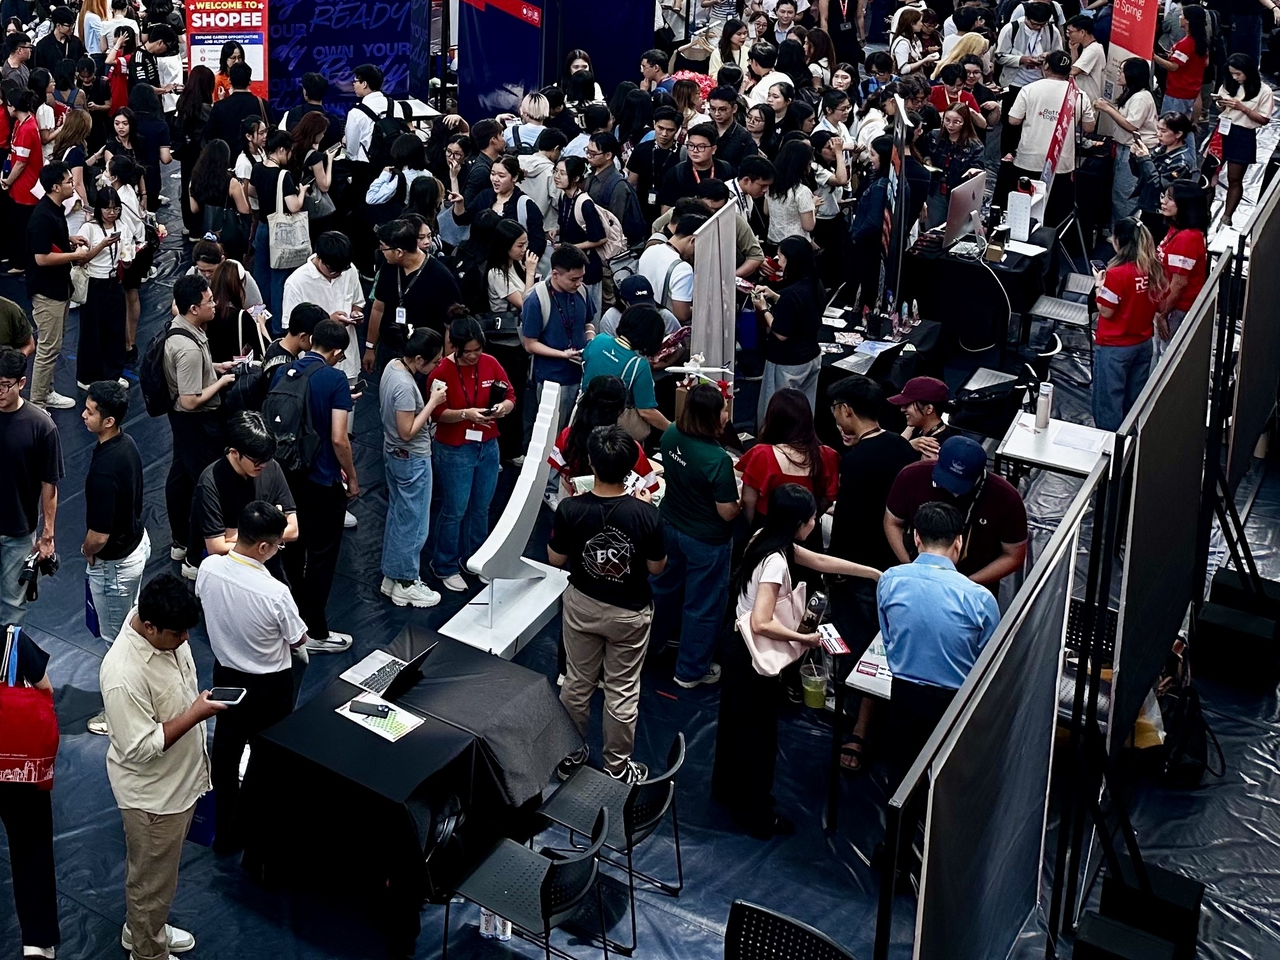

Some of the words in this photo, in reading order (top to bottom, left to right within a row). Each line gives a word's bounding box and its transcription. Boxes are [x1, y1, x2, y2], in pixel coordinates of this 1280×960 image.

[195, 1, 242, 10] WELCOME
[244, 1, 258, 9] TO
[191, 12, 262, 27] SHOPEE
[312, 44, 354, 60] OWN
